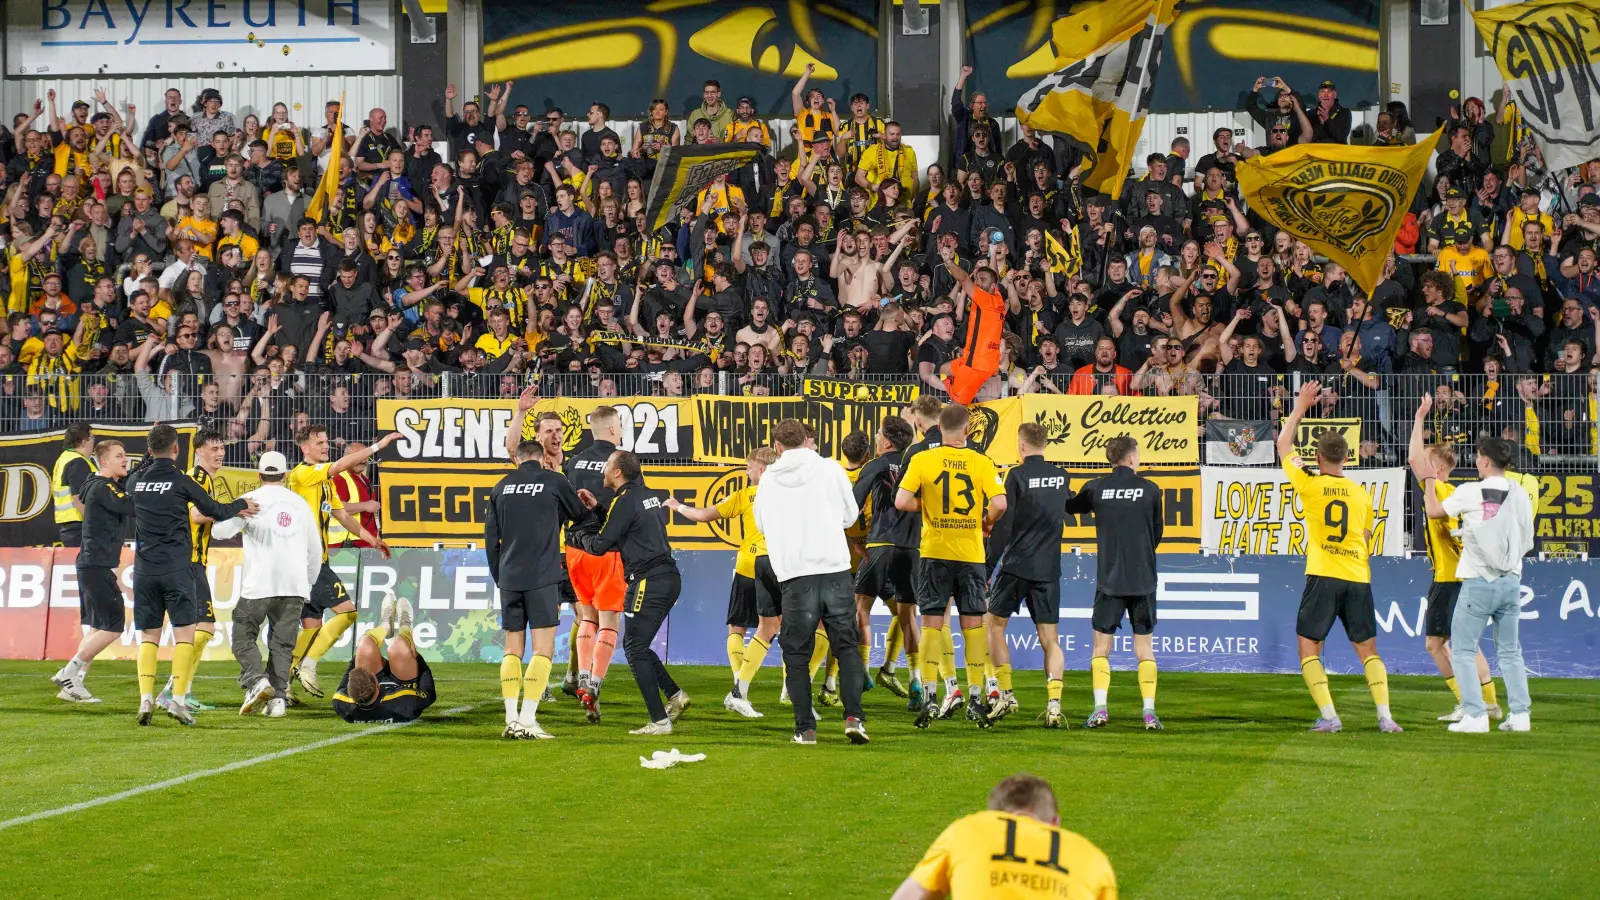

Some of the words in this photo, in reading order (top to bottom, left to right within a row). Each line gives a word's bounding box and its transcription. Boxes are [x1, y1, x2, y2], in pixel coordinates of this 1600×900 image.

[1081, 400, 1187, 429] Collettivo
[394, 407, 513, 459] SZENE
[587, 402, 679, 454] 021
[696, 400, 846, 460] WAGNEADT
[1081, 429, 1130, 456] Gia
[1144, 430, 1188, 451] Nero
[943, 458, 967, 470] SYHRE
[145, 481, 172, 494] cep
[515, 483, 544, 497] cep
[933, 470, 975, 515] 13
[1041, 476, 1065, 489] cep
[1116, 488, 1144, 501] cep
[1323, 487, 1350, 497] MINTAL
[1537, 475, 1594, 515] 25
[1215, 481, 1274, 520] LOVE
[1324, 499, 1348, 543] 9
[1537, 517, 1600, 537] AHR
[1219, 520, 1282, 555] HATE
[1112, 635, 1259, 654] TEERBERATER
[990, 816, 1069, 875] 11
[990, 871, 1069, 898] BAYREUTH
